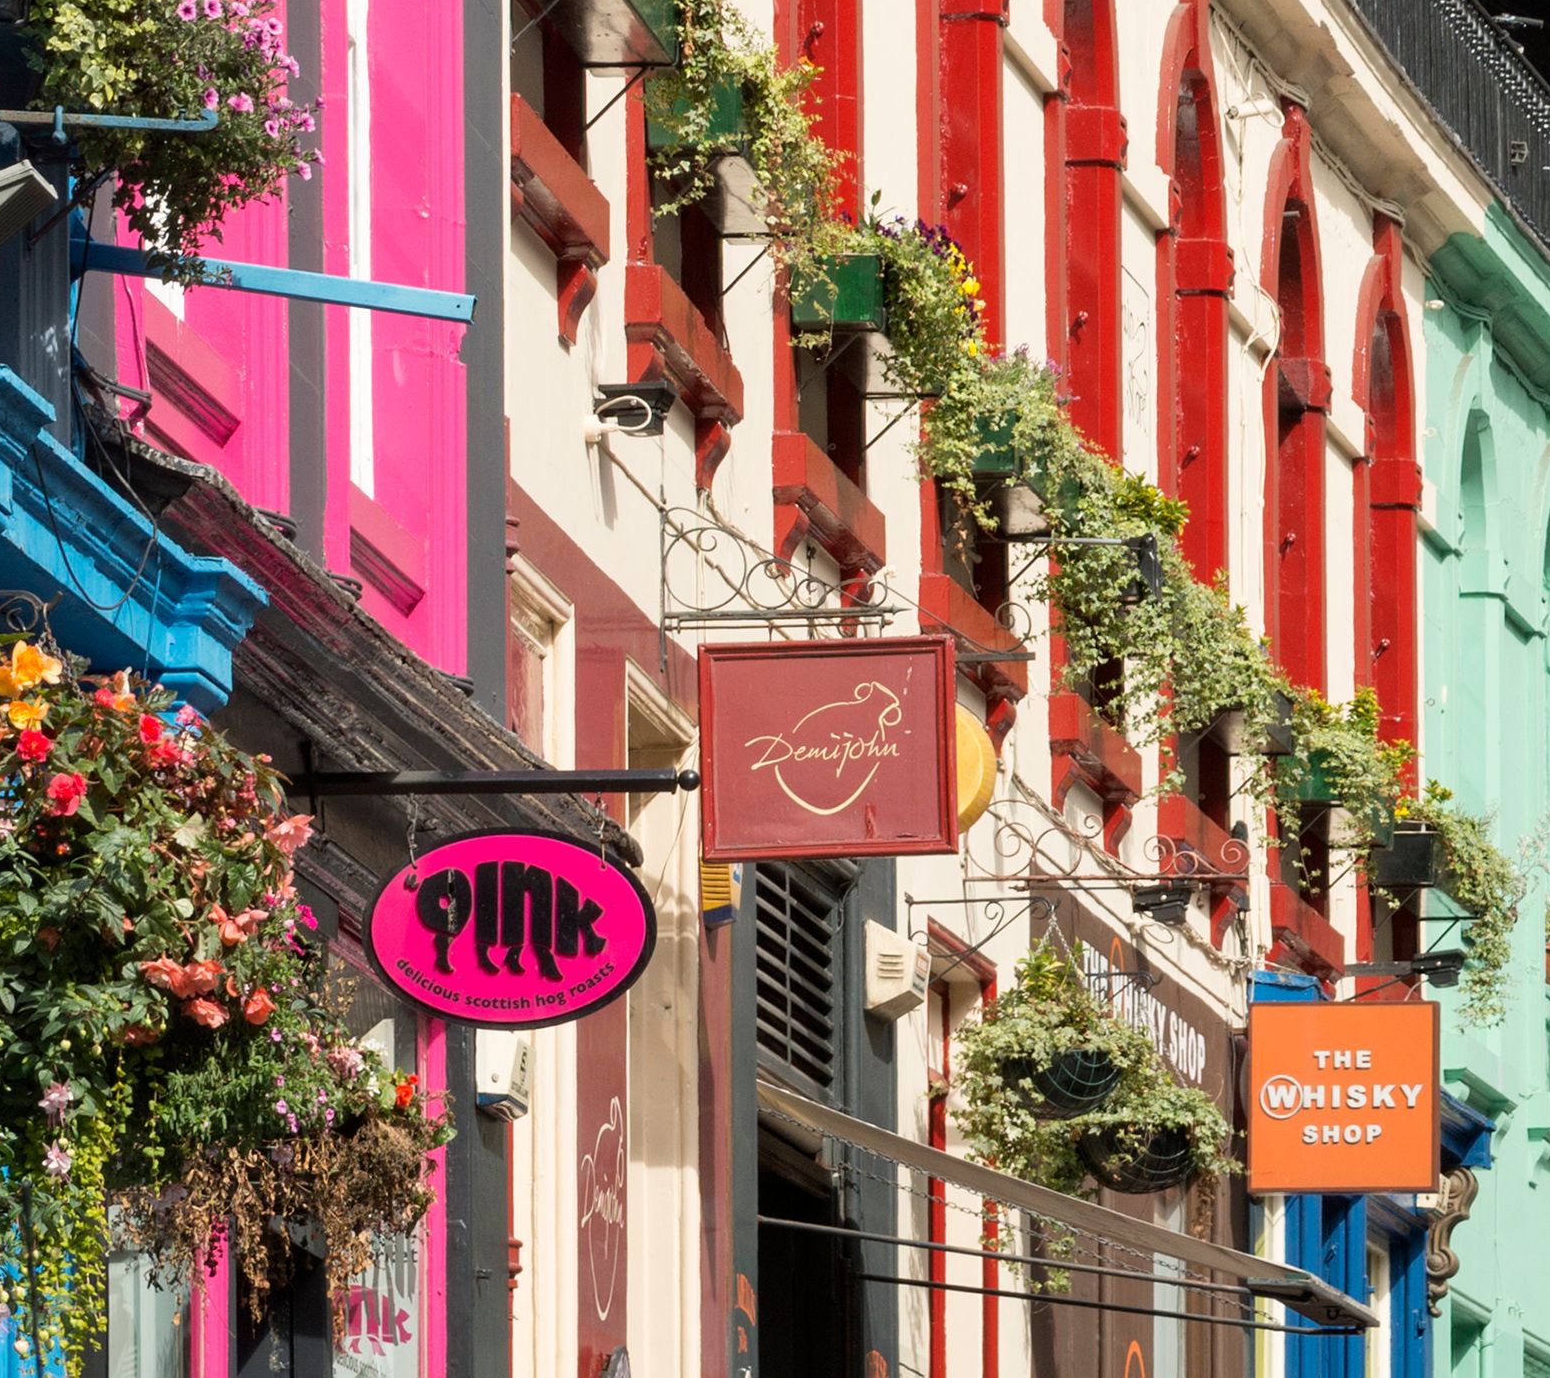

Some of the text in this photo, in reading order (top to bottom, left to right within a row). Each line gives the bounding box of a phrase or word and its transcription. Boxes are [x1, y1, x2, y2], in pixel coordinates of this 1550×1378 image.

[744, 729, 900, 778] Demijohn
[396, 958, 615, 1009] delicious scottish hog roasts
[1169, 1011, 1206, 1084] SHOP
[1313, 1050, 1372, 1069] THE
[1266, 1084, 1423, 1109] WHISKY
[1303, 1124, 1382, 1144] SHOP
